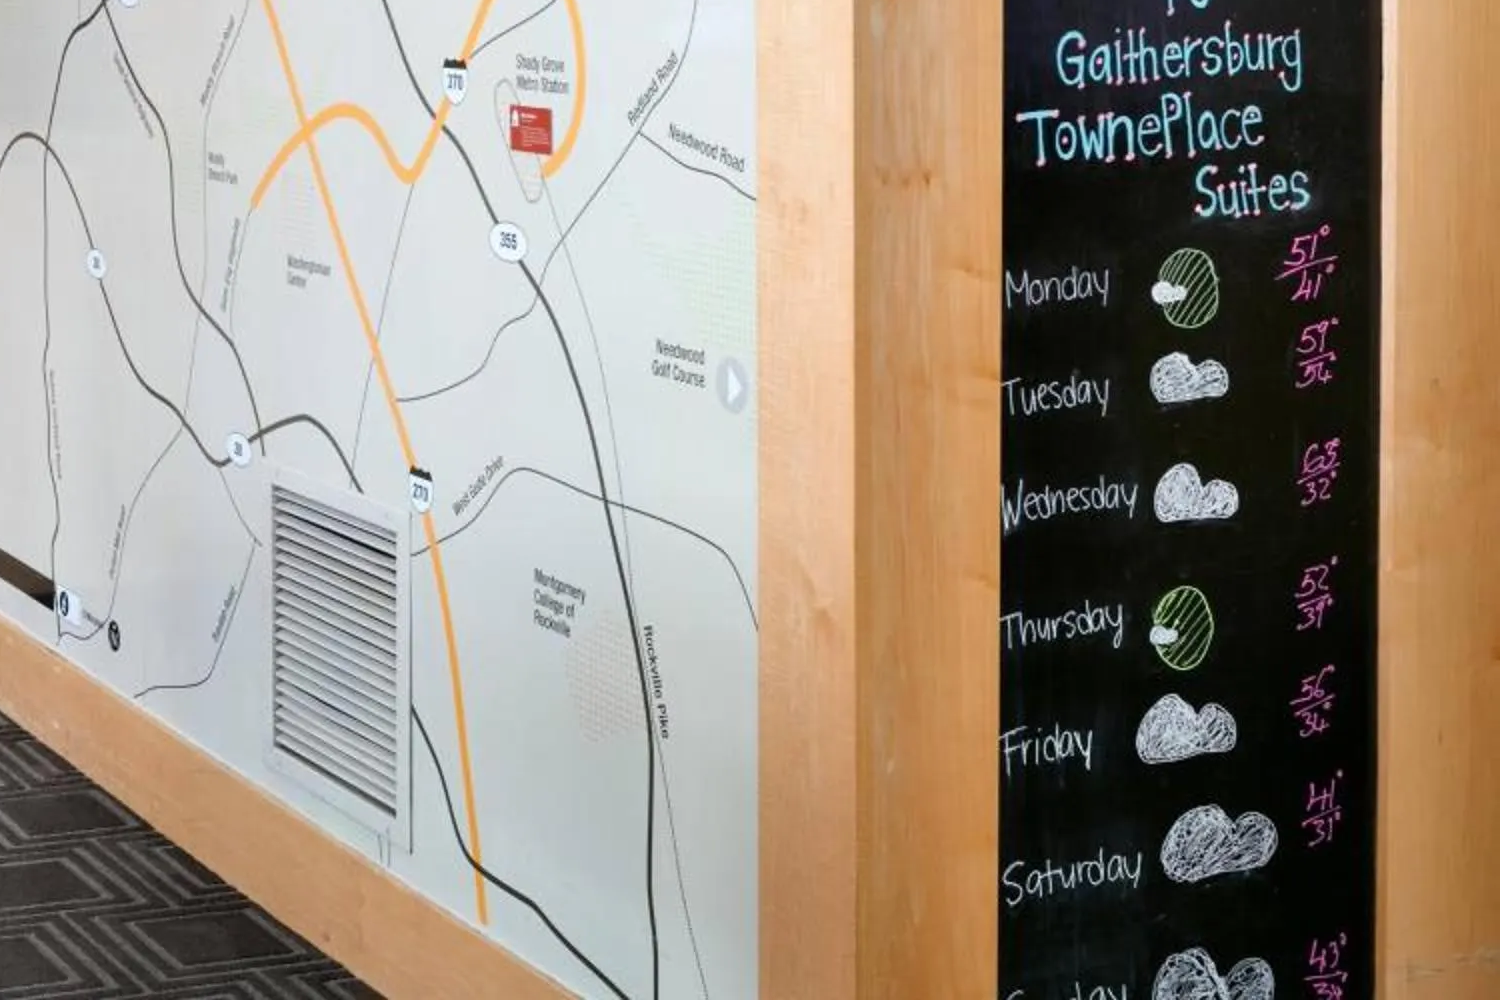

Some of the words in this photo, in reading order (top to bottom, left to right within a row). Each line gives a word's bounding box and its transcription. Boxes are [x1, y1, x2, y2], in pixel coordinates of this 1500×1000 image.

[515, 53, 539, 74] Shady
[541, 56, 565, 74] Grove
[1055, 19, 1303, 93] Gaithersburg
[515, 75, 538, 91] Metro
[541, 77, 570, 94] Station
[627, 78, 659, 127] Redland
[655, 49, 678, 83] Road
[668, 122, 719, 161] Needwood
[719, 146, 745, 173] Road
[1015, 90, 1266, 168] TownePlace
[1194, 162, 1312, 219] Suites
[498, 232, 518, 250] 355
[1004, 265, 1111, 309] Monday
[651, 358, 671, 379] Golf
[671, 363, 706, 389] Course
[655, 338, 705, 365] Needwood
[1000, 375, 1111, 418] Tuesday
[1000, 474, 1139, 538] Wednesday
[533, 567, 587, 606] Montgomery
[533, 588, 564, 615] College
[565, 603, 575, 618] of
[533, 609, 572, 639] Rockville
[999, 599, 1125, 650] Thursday
[643, 625, 663, 699] Rockville
[657, 703, 669, 740] Pike
[998, 721, 1094, 778] Friday
[1001, 847, 1144, 907] Saturday
